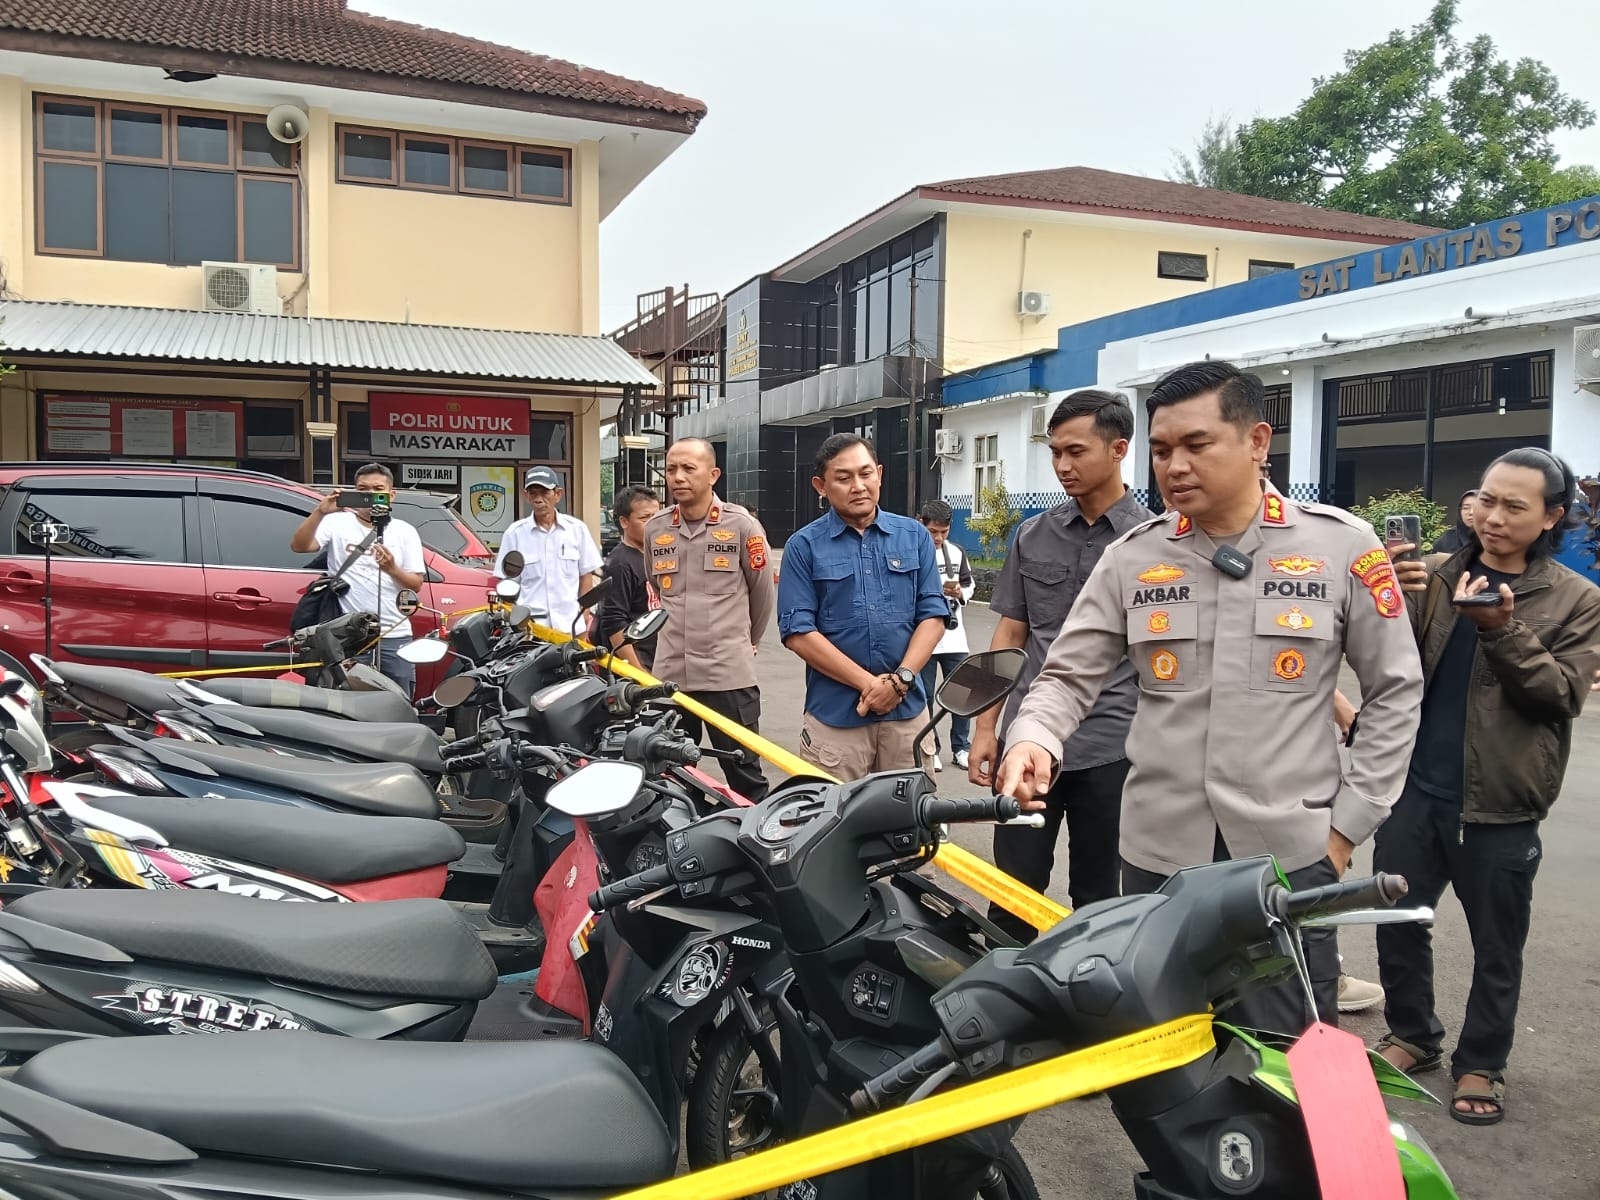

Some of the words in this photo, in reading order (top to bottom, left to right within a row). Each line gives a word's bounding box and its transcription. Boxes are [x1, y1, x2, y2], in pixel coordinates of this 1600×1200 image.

[1299, 259, 1356, 299] SAT
[1373, 221, 1523, 284] LANTAS
[389, 413, 444, 428] POLRI
[450, 415, 513, 431] UNTUK
[389, 434, 516, 452] MASYARAKAT
[408, 468, 432, 479] SIDIK
[433, 469, 453, 480] JARI
[653, 547, 676, 557] DENY
[707, 544, 737, 553] POLRI
[1132, 585, 1190, 606] AKBAR
[1263, 581, 1327, 599] POLRI
[731, 935, 771, 950] HONDA
